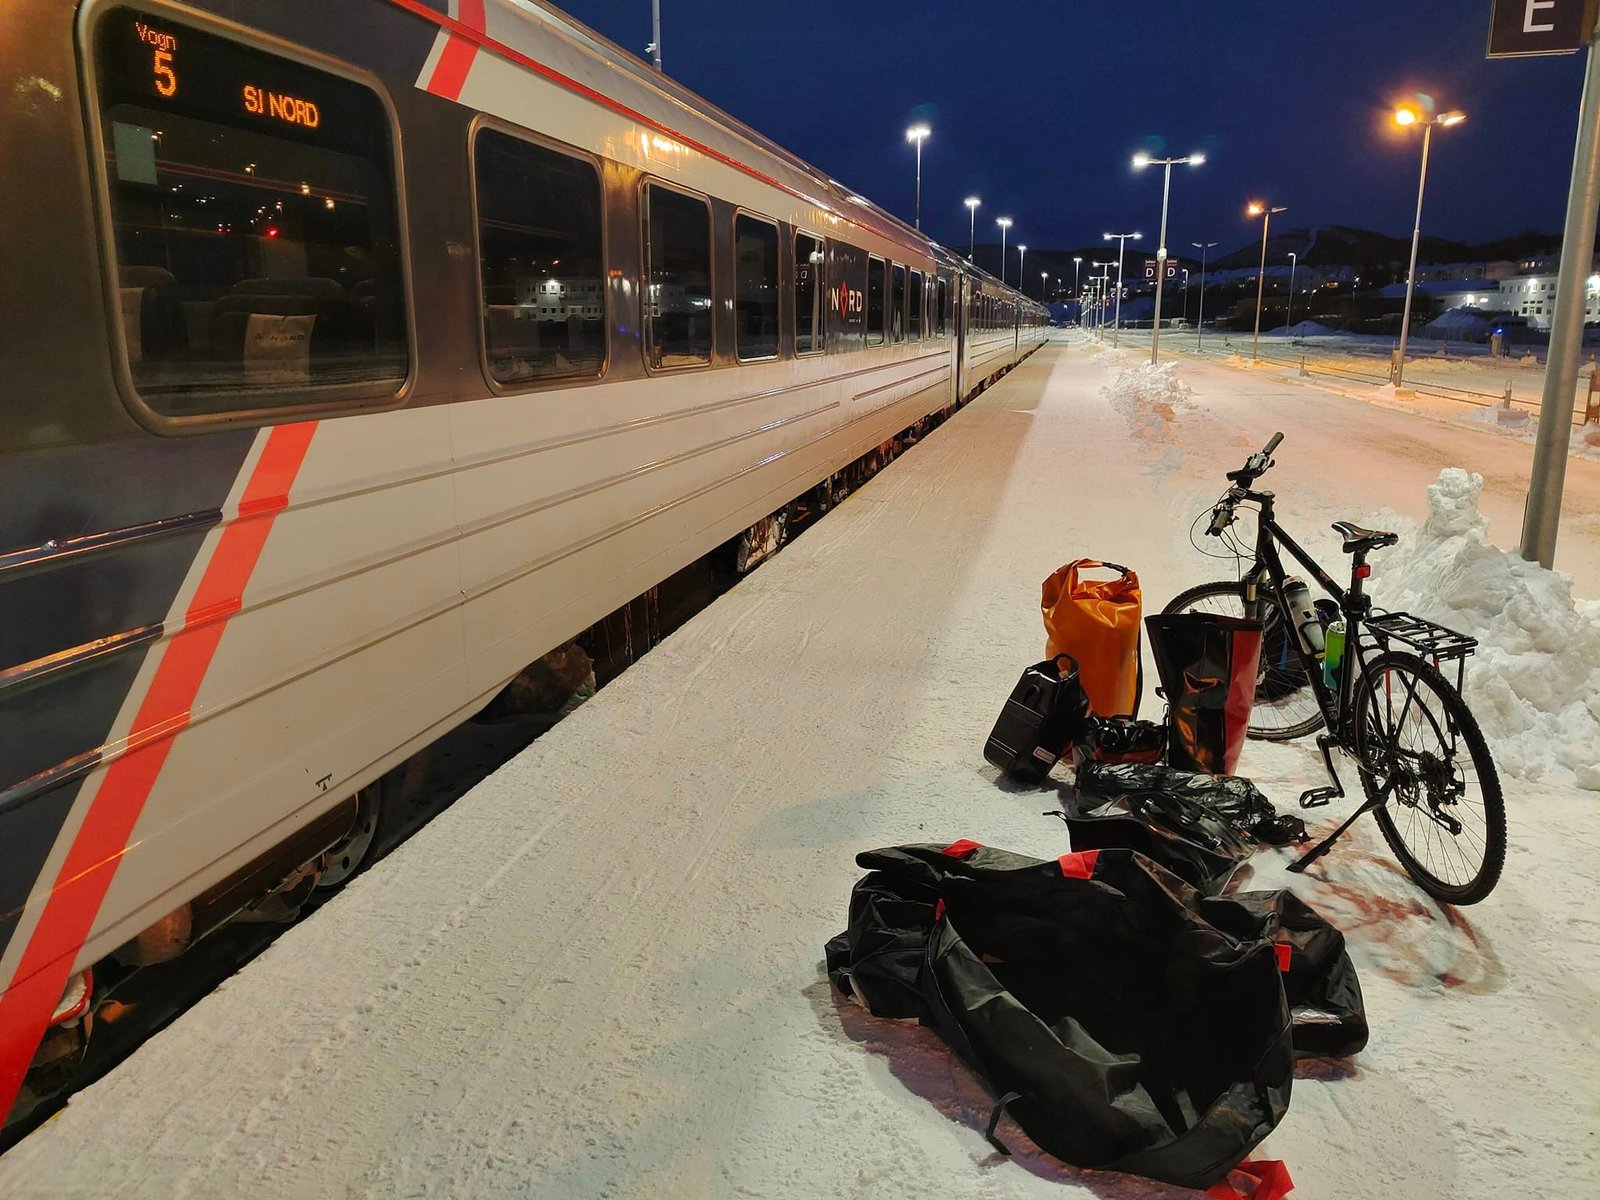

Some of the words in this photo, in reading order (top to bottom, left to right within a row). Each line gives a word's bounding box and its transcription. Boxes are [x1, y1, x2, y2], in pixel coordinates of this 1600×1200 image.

[1523, 0, 1555, 32] E
[135, 21, 177, 51] Vogn
[154, 50, 177, 97] 5
[269, 91, 319, 128] NORD
[1145, 267, 1154, 277] D
[1168, 267, 1176, 277] D
